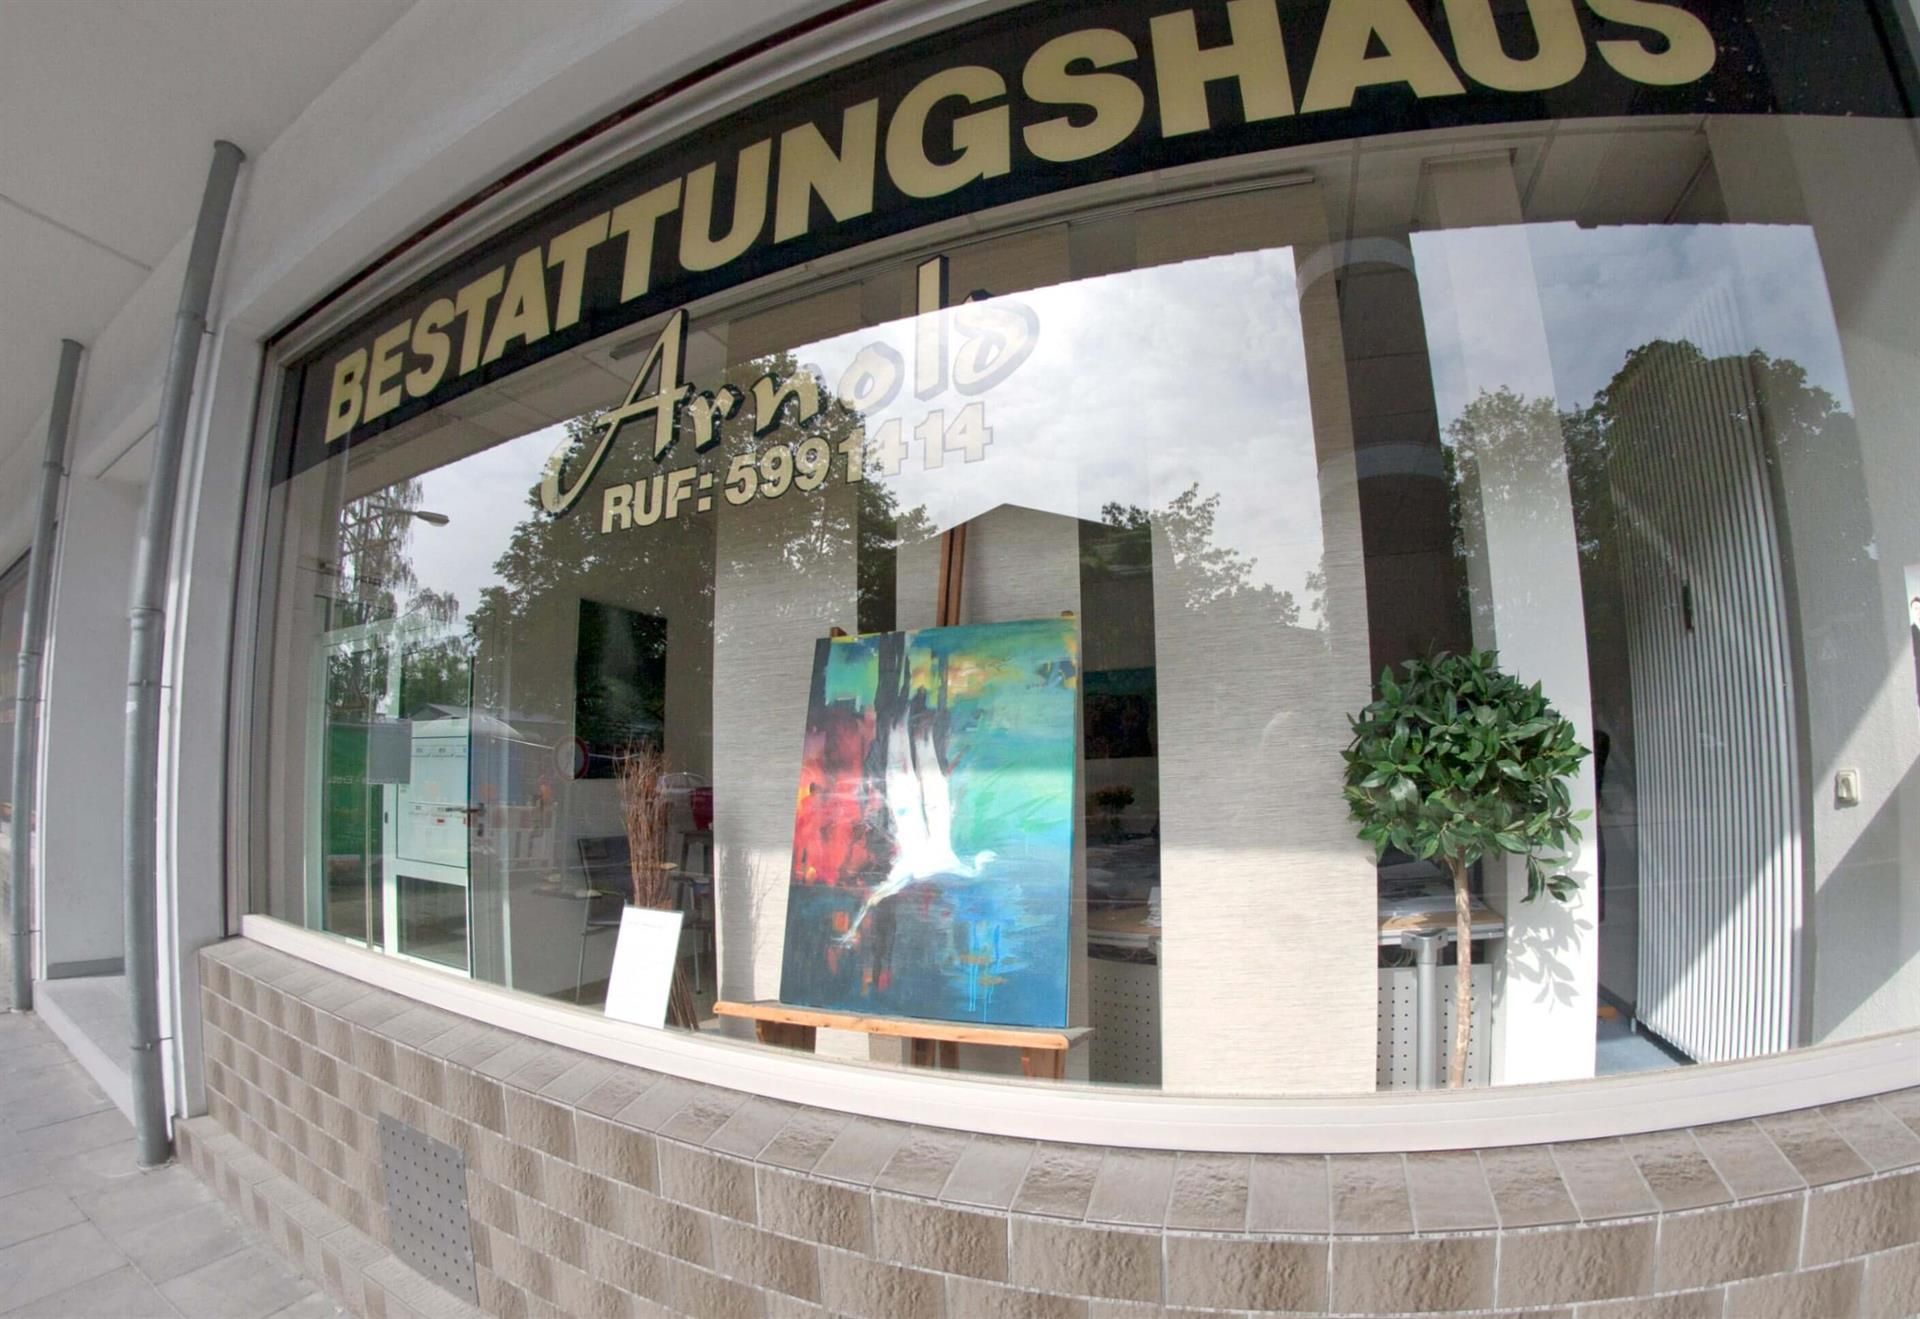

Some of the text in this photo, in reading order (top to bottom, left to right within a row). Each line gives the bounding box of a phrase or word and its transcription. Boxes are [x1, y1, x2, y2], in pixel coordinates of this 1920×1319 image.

[325, 0, 1717, 443] BESTATTUNGSHAUS
[541, 255, 1040, 519] Arnold
[601, 401, 994, 534] RUF: 5991414
